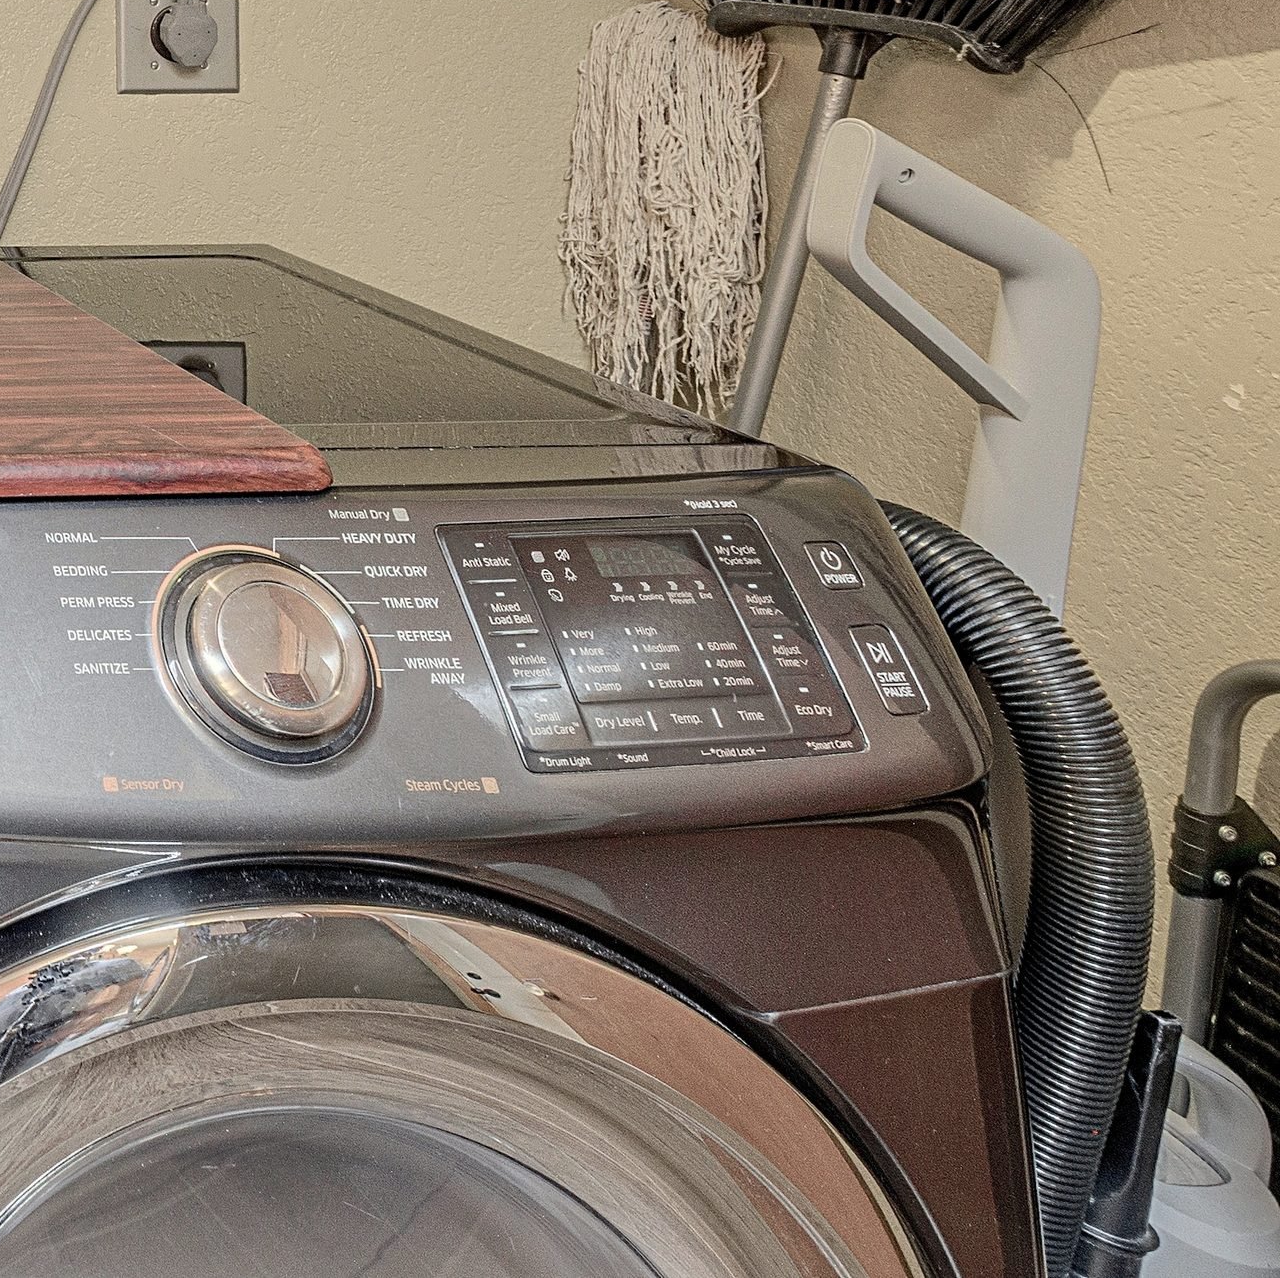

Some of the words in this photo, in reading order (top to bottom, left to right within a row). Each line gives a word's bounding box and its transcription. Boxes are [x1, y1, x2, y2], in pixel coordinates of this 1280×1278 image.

[328, 509, 366, 520] Manual
[369, 509, 390, 522] Dry
[45, 532, 98, 544] NORMAL
[342, 533, 382, 545] HEAVY
[385, 533, 417, 545] DUTY
[714, 546, 728, 558] My
[730, 544, 756, 556] Cycle
[463, 557, 482, 568] Anti
[484, 556, 511, 568] Static
[54, 566, 108, 577] BEDDING
[364, 566, 401, 578] QUICK
[403, 566, 428, 577] DRY
[823, 573, 858, 584] POWER
[60, 597, 94, 608] PERM
[97, 597, 135, 608] PRESS
[382, 597, 411, 608] TIME
[414, 597, 439, 608] DRY
[746, 593, 774, 606] Adjust
[490, 602, 520, 613] Mixed
[750, 605, 772, 616] Time
[488, 614, 510, 625] Load
[513, 614, 533, 625] Bell
[67, 629, 132, 641] DELICATES
[396, 630, 452, 641] REFRESH
[572, 628, 594, 641] Very
[635, 625, 657, 638] High
[579, 646, 604, 657] More
[643, 643, 679, 654] Medium
[707, 642, 737, 652] 60min
[772, 645, 801, 657] Adjust
[405, 658, 462, 670] WRINKLE
[509, 654, 546, 666] Wrinkle
[74, 663, 130, 674] SANITIZE
[513, 667, 552, 678] Prevent
[430, 674, 466, 684] AWAY
[121, 779, 157, 791] Sensor
[159, 778, 184, 792] Dry
[405, 779, 440, 791] Steam
[442, 779, 480, 793] Cycles
